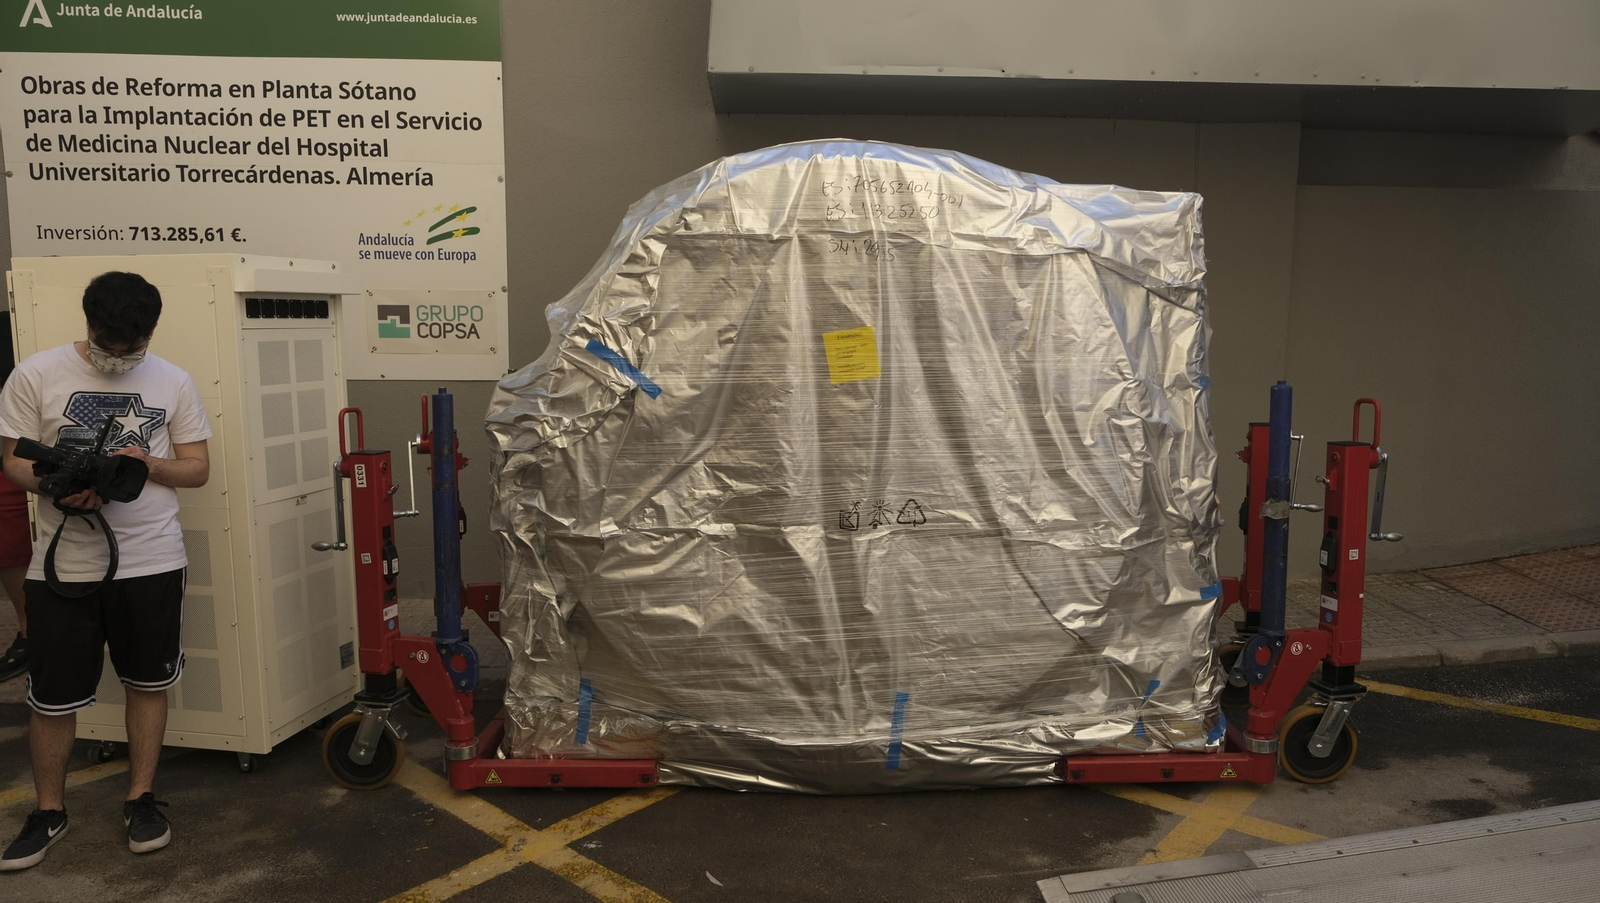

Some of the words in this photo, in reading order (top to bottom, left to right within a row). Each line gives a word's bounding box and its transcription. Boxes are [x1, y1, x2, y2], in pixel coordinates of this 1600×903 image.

[56, 2, 100, 17] Junta
[103, 2, 123, 17] de
[126, 4, 203, 20] Andalucía
[336, 12, 478, 25] www.juntadeandalucia.es
[20, 75, 86, 95] Obras
[91, 76, 119, 96] de
[125, 77, 223, 98] Reforma
[228, 83, 256, 99] en
[262, 80, 333, 100] Planta
[338, 80, 417, 102] Sótano
[23, 108, 73, 129] para
[78, 104, 98, 125] la
[103, 105, 254, 131] Implantación
[259, 107, 287, 129] de
[292, 109, 332, 129] PET
[337, 113, 365, 130] en
[370, 110, 390, 131] el
[396, 111, 483, 132] Servicio
[25, 132, 52, 153] de
[57, 133, 158, 155] Medicina
[164, 135, 251, 156] Nuclear
[257, 136, 290, 157] del
[296, 138, 389, 162] Hospital
[28, 161, 171, 183] Universitario
[175, 163, 341, 186] Torrecárdenas.
[346, 166, 434, 187] Almería
[36, 224, 124, 242] Inversión:
[128, 226, 225, 245] 713.285,61
[230, 227, 247, 243] €.
[358, 232, 415, 247] Andalucía
[358, 249, 371, 260] se
[373, 249, 412, 261] mueve
[414, 250, 435, 261] con
[437, 247, 477, 264] Europa
[415, 304, 484, 323] GRUPO
[416, 322, 482, 340] COPSA
[356, 465, 365, 485] 0331
